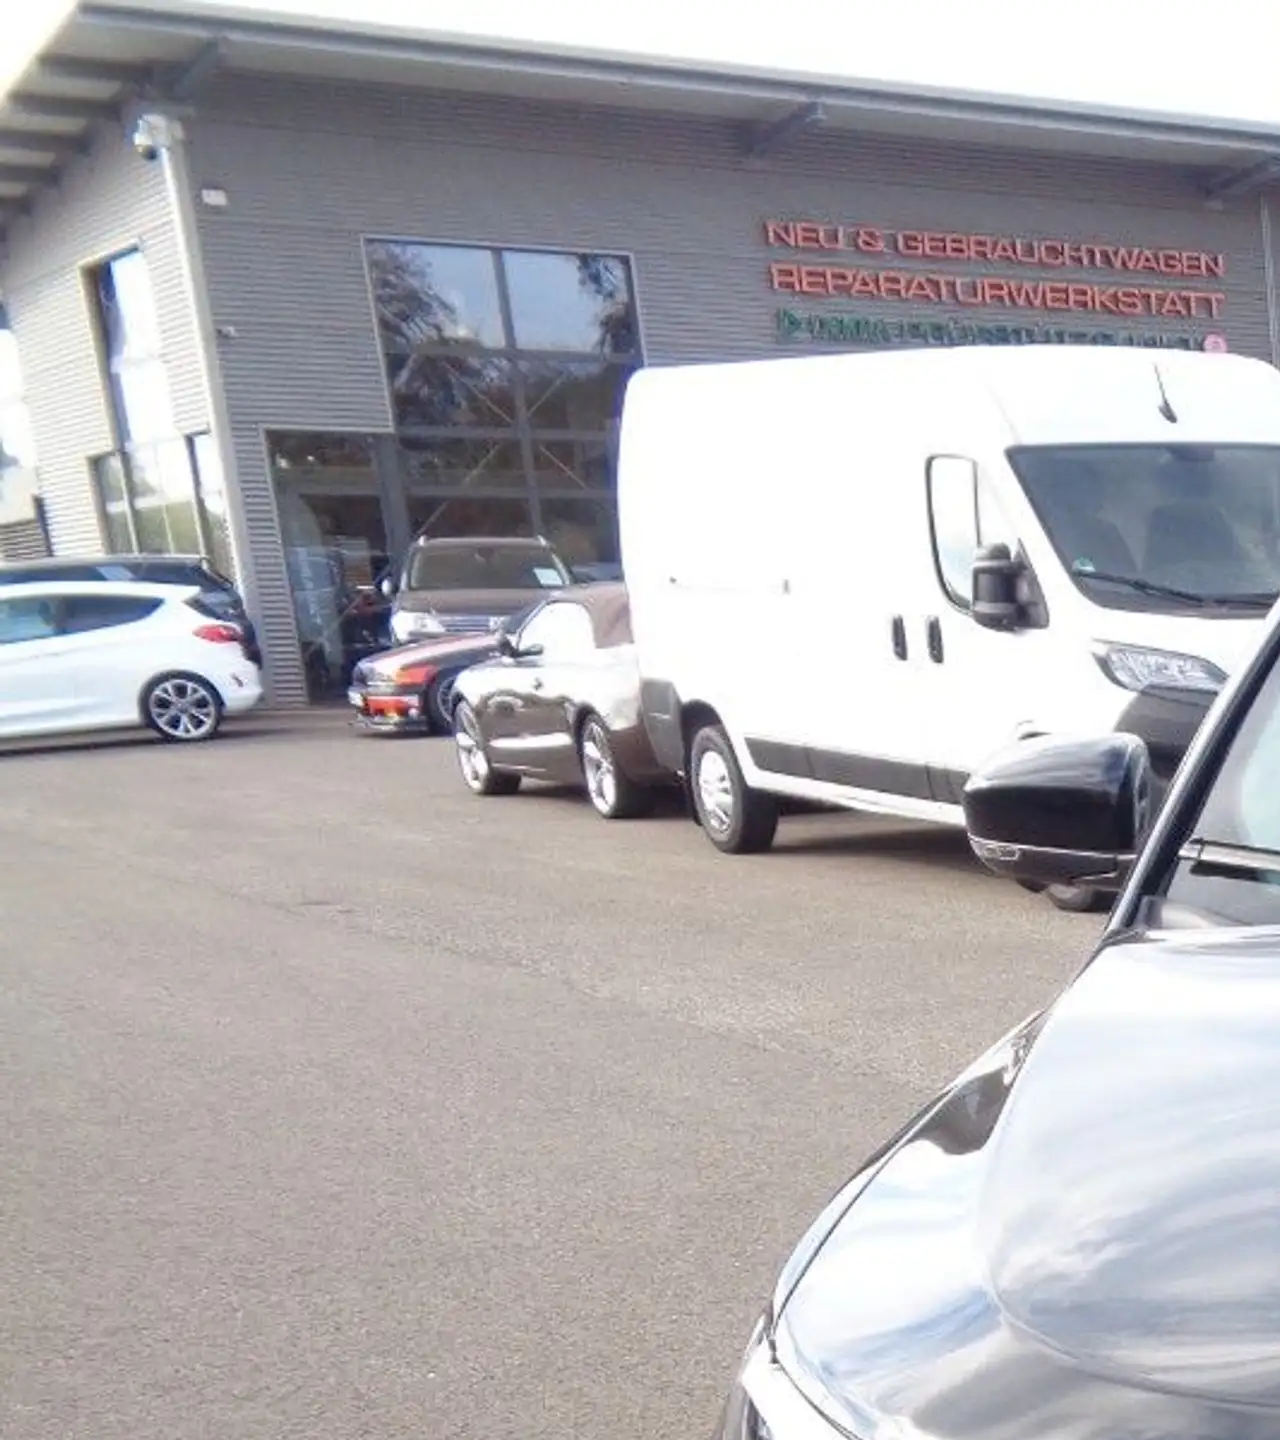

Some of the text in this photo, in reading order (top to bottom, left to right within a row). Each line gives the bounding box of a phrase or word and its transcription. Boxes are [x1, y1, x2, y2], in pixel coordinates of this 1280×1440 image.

[764, 221, 1226, 278] NEU & GEBRAUCHTWAGEN
[769, 262, 1226, 320] REPARATURWERKSTATT
